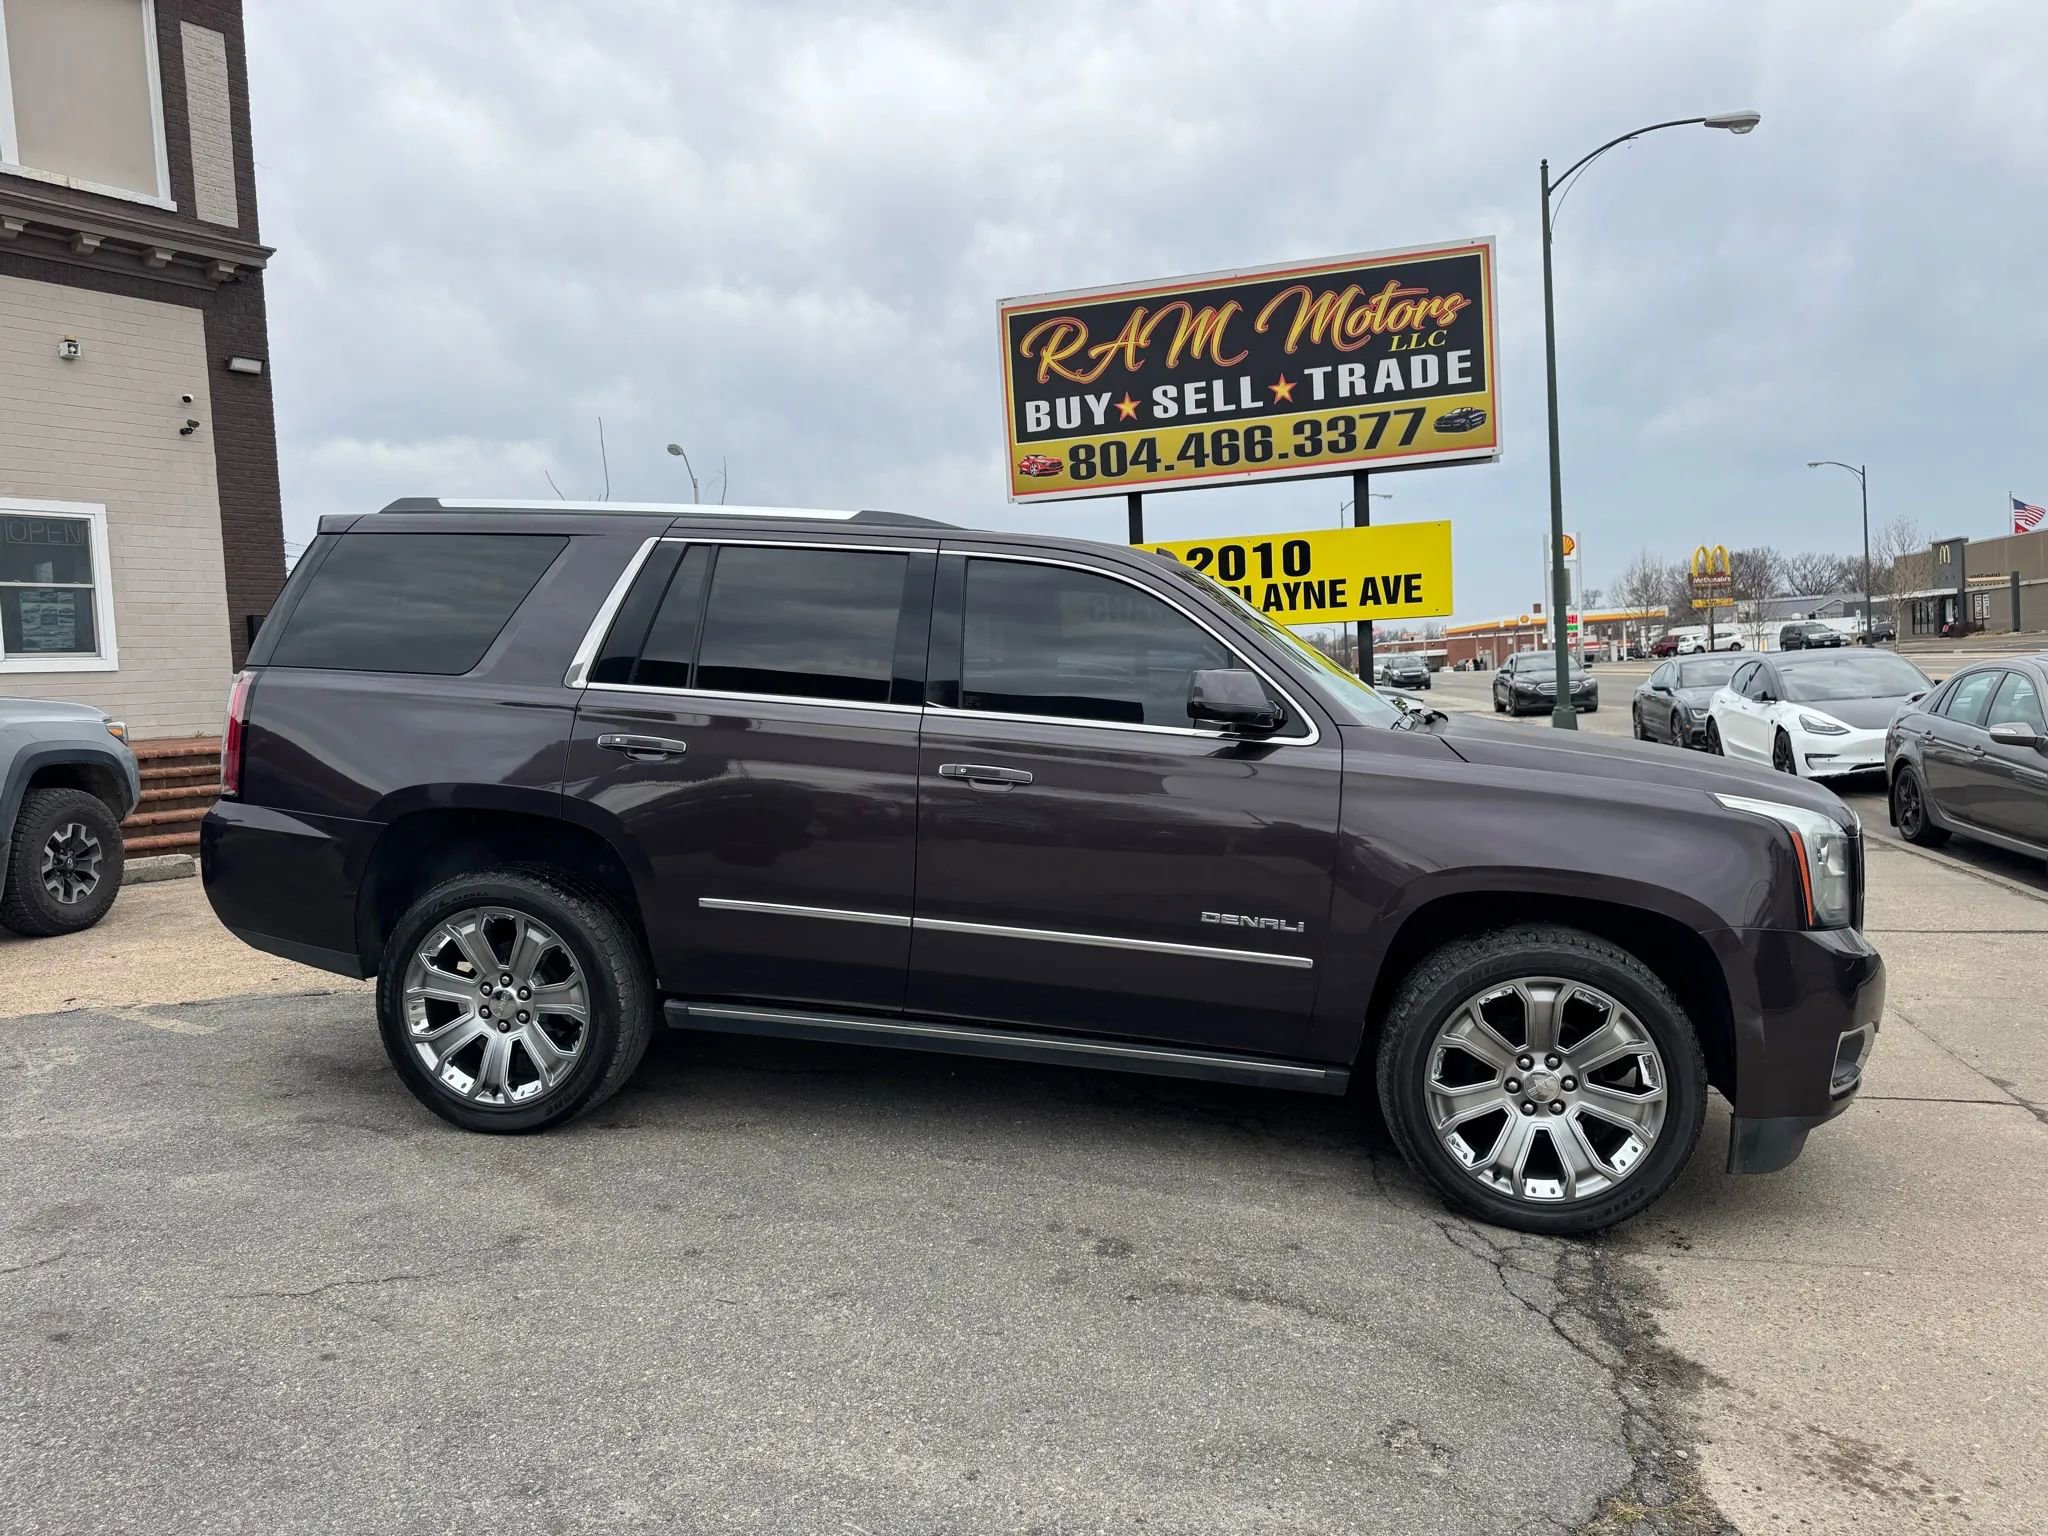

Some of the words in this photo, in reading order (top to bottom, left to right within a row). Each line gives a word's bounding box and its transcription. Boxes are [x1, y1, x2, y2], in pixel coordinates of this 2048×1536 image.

[1254, 280, 1472, 353] Motors
[1389, 329, 1448, 352] LLC
[1025, 391, 1113, 433] BUY
[1152, 375, 1264, 419] SELL
[1304, 348, 1473, 401] TRADE
[1068, 406, 1427, 481] 804.466.3377
[9, 519, 80, 544] OPEN
[1186, 539, 1311, 581] 2010
[1359, 573, 1423, 606] AVE
[1200, 911, 1305, 933] DENALI
